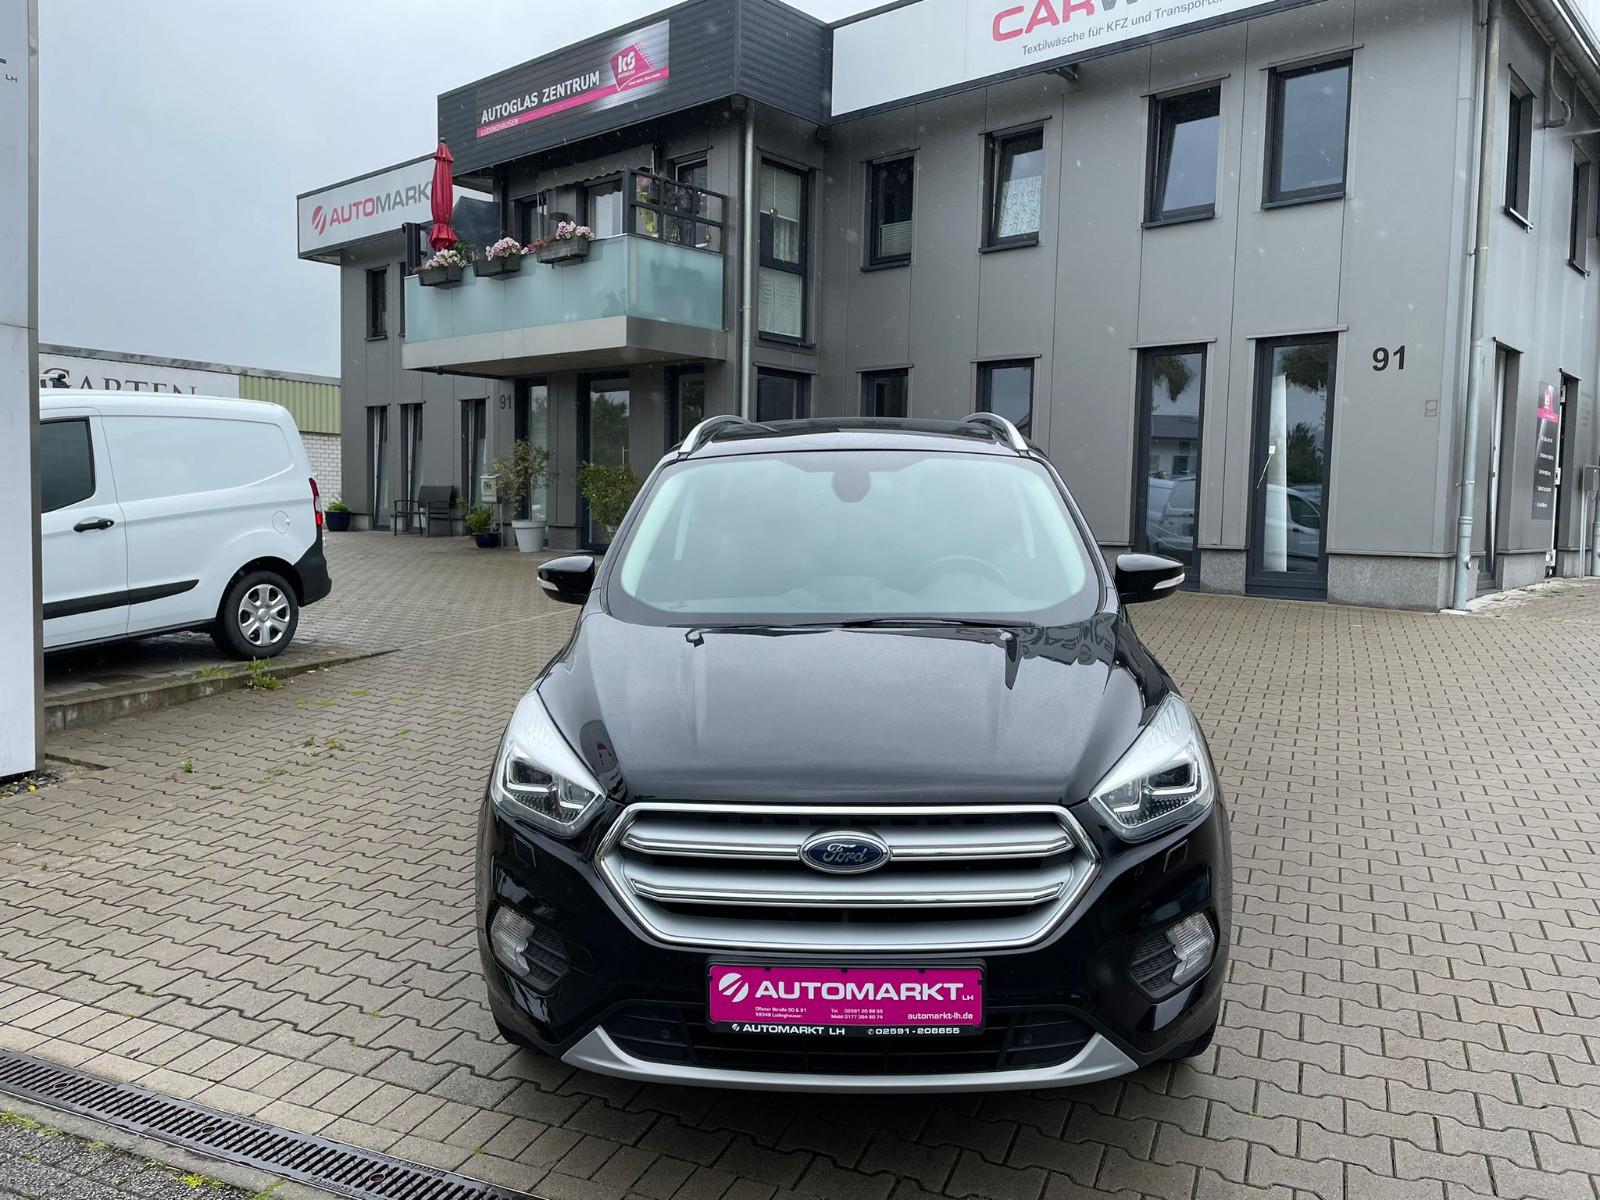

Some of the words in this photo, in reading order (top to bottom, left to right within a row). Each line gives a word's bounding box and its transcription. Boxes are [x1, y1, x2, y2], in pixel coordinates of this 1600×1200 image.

[1022, 31, 1085, 55] Textilwäsche
[1088, 25, 1104, 40] für
[1106, 17, 1129, 33] KFZ
[1131, 11, 1152, 26] und
[481, 91, 538, 124] AUTOGLAS
[542, 70, 600, 103] ZENTRUM
[329, 181, 432, 227] AUTOMARK
[1372, 345, 1406, 372] 91
[500, 394, 512, 410] 91
[822, 843, 868, 863] Ford
[755, 980, 964, 1001] AUTOMARKT
[907, 1011, 973, 1020] automarkt-lh.de
[743, 1024, 824, 1035] AUTOMARKT
[829, 1027, 845, 1035] LH
